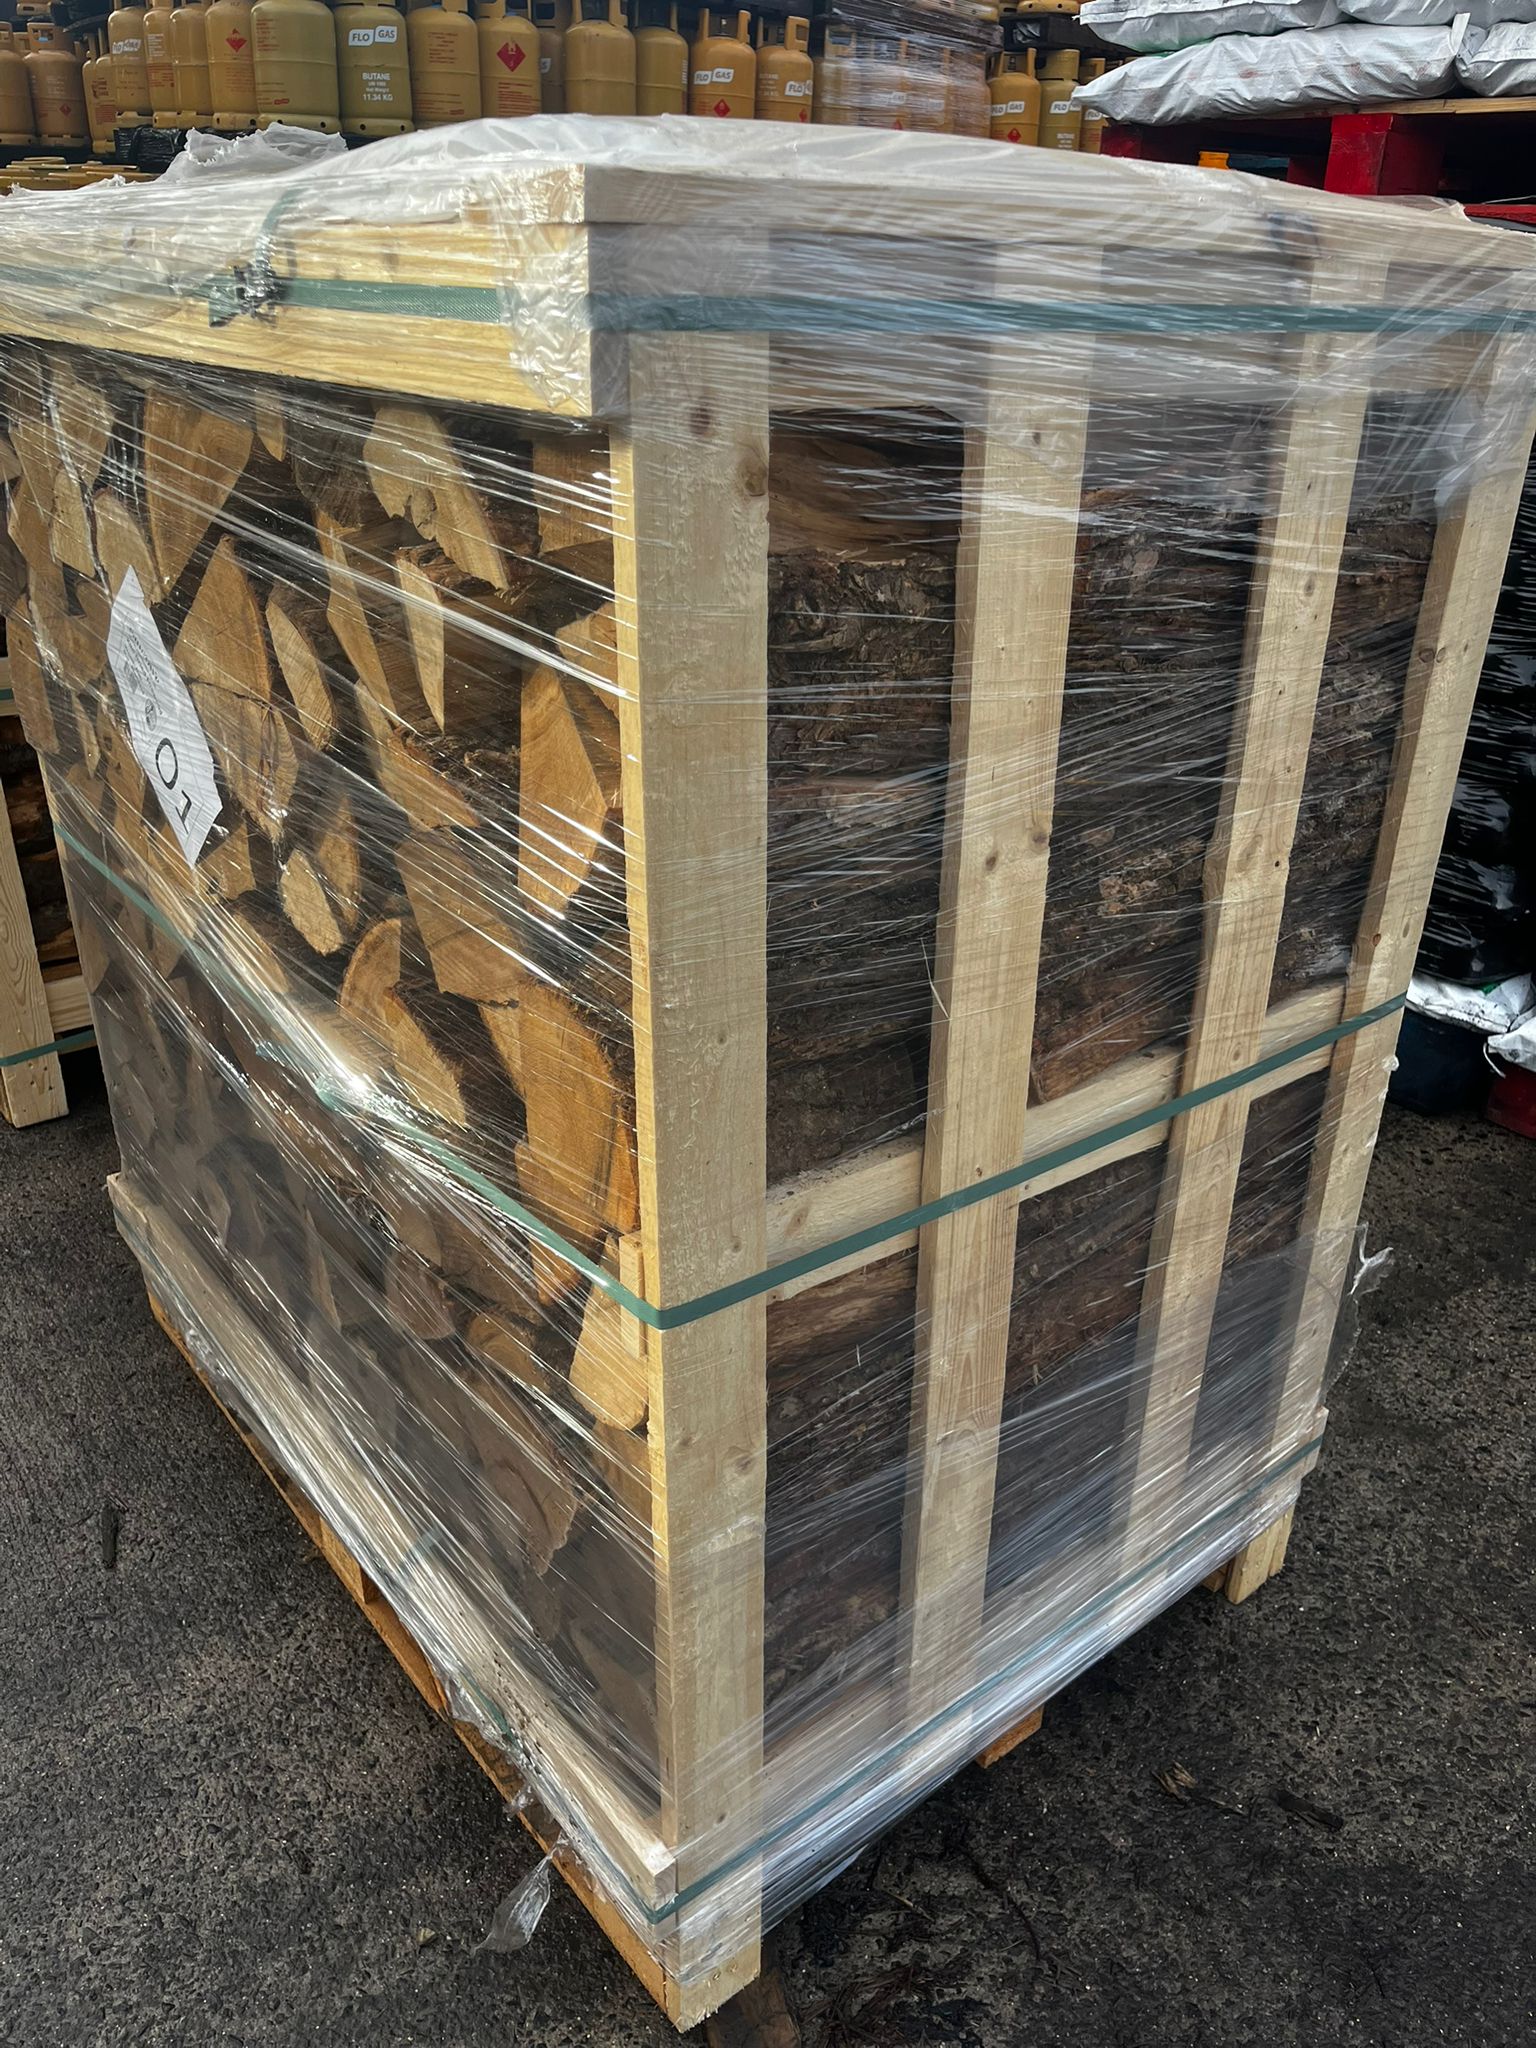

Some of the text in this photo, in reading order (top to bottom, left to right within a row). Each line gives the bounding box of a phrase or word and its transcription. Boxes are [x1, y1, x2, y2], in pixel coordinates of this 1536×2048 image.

[352, 29, 396, 42] FLO GAS
[362, 72, 391, 81] BUTANE
[696, 71, 731, 82] FLO GAS
[788, 83, 803, 93] FLO
